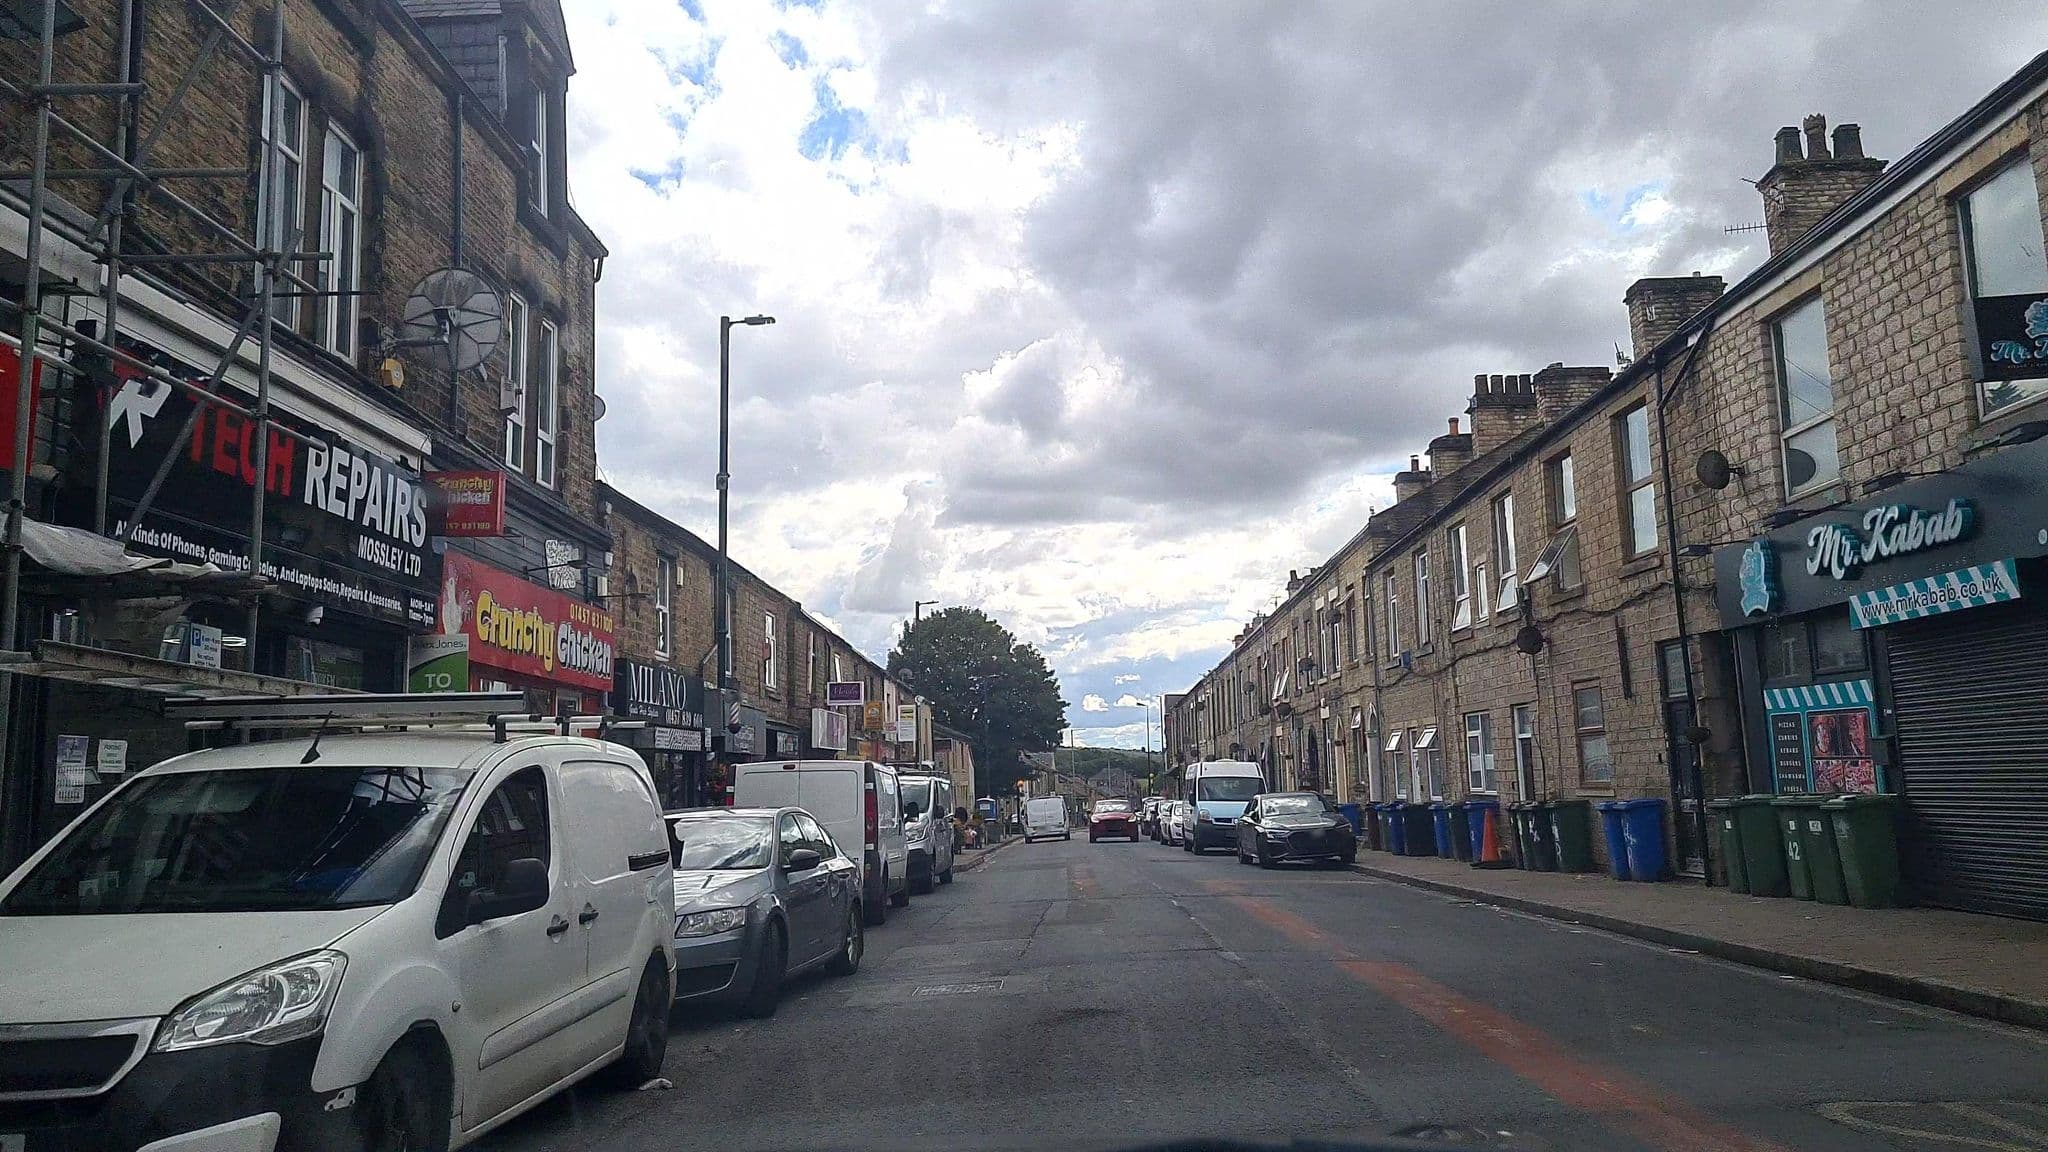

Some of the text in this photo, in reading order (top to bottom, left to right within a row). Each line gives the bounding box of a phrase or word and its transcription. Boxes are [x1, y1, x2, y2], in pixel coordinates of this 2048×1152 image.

[186, 380, 297, 497] TECH
[304, 445, 428, 548] REPAIRS
[130, 522, 160, 547] Kinds
[160, 532, 173, 550] Of
[173, 534, 208, 562] Phones,
[208, 546, 242, 572] Gaming
[280, 566, 295, 583] And
[295, 570, 323, 593] Laptops
[358, 534, 422, 577] MOSSLEY LTD
[1806, 498, 1965, 580] Mr. Kabab
[1861, 571, 2003, 620] www.mrkabab.co.uk
[476, 590, 612, 679] Crunchy Chicken
[424, 673, 452, 689] TO
[629, 662, 687, 711] MILANO
[1788, 840, 1800, 860] 42
